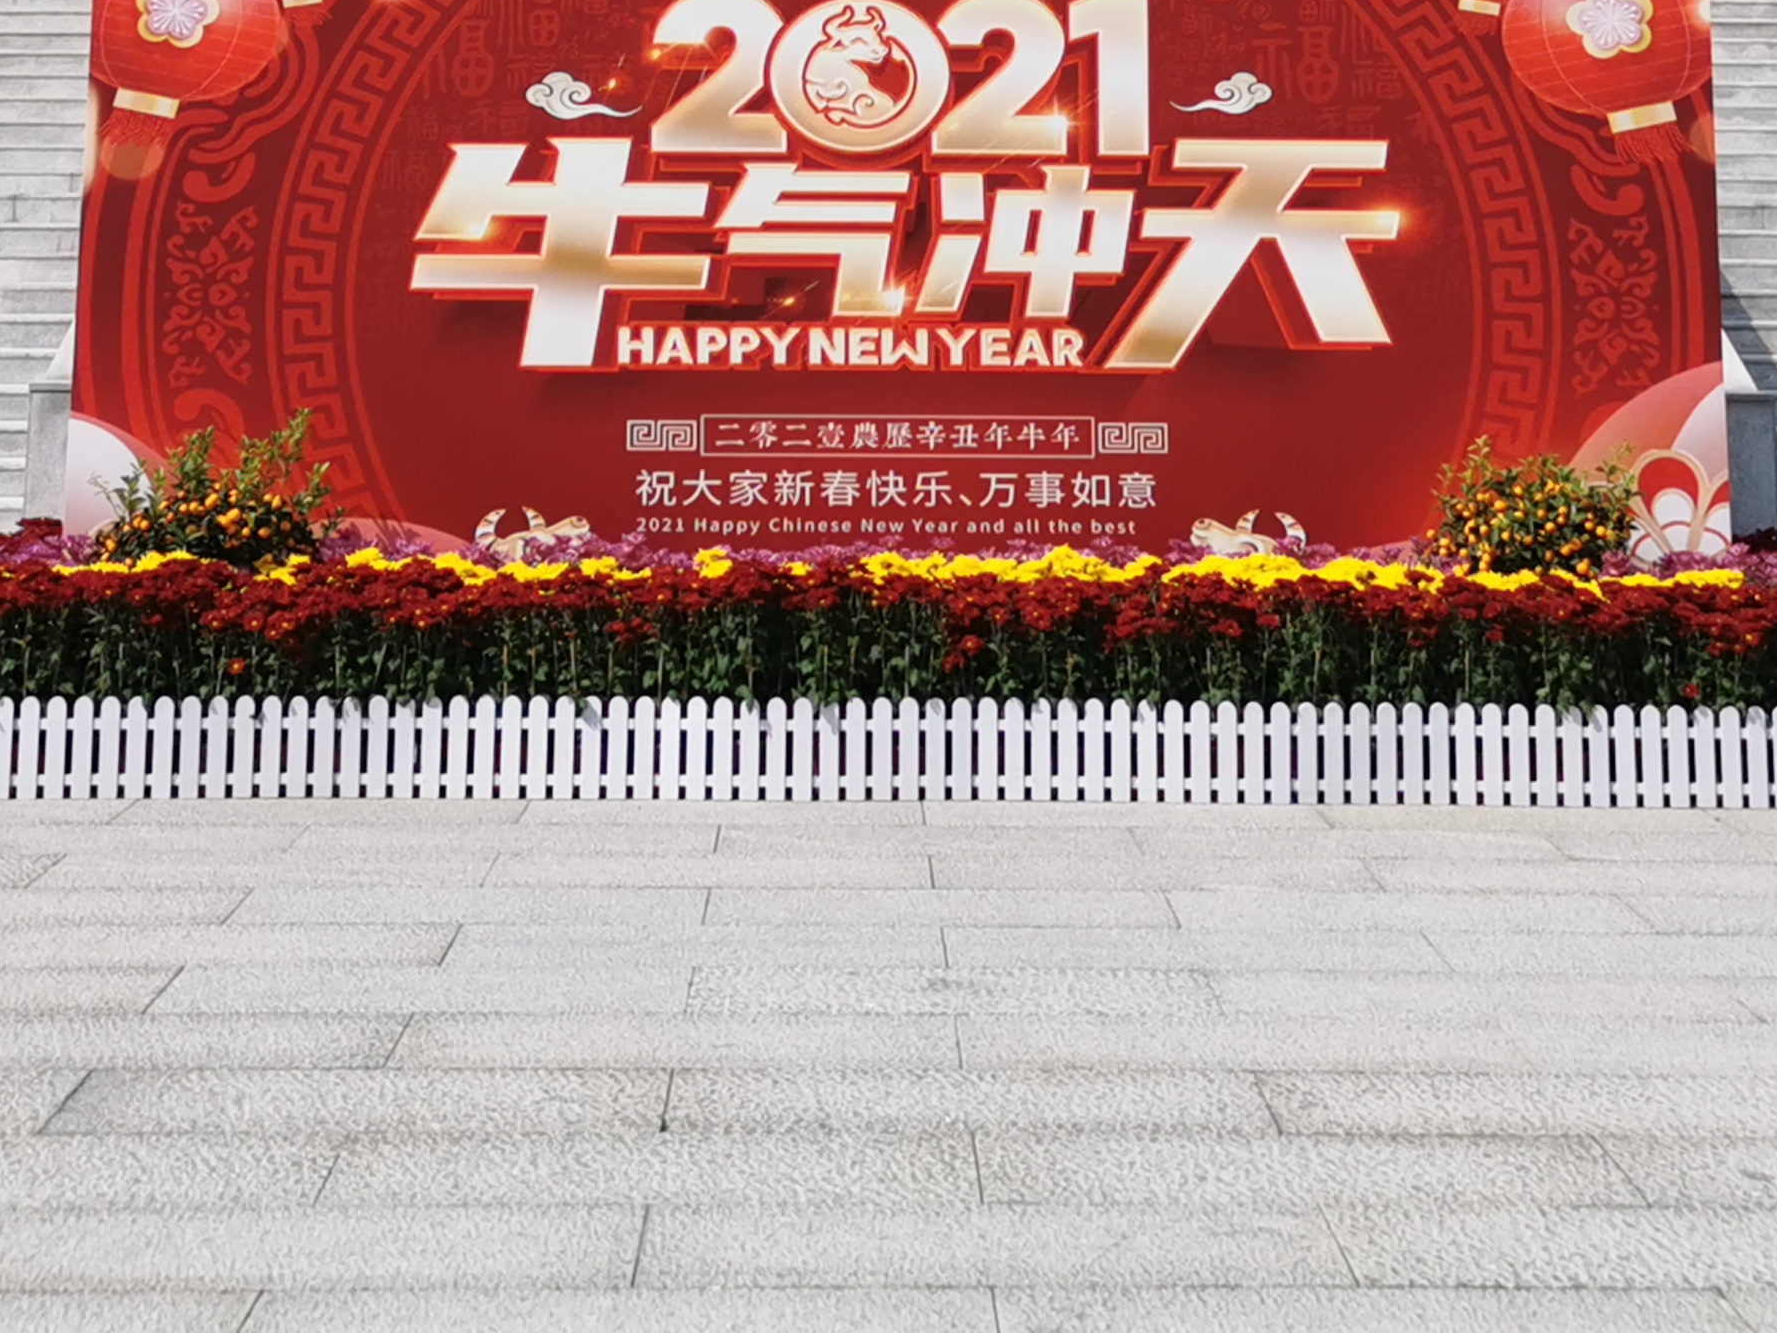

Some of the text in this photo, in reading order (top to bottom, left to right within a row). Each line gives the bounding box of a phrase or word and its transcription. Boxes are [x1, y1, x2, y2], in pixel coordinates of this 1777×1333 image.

[408, 136, 1400, 369] 牛气冲天
[617, 326, 1084, 367] HAPPY NEW YEAR
[635, 468, 1157, 509] 祝大家新春快乐、万事如意
[636, 517, 1136, 537] 2021 Happy Chinese New Year and all the best
